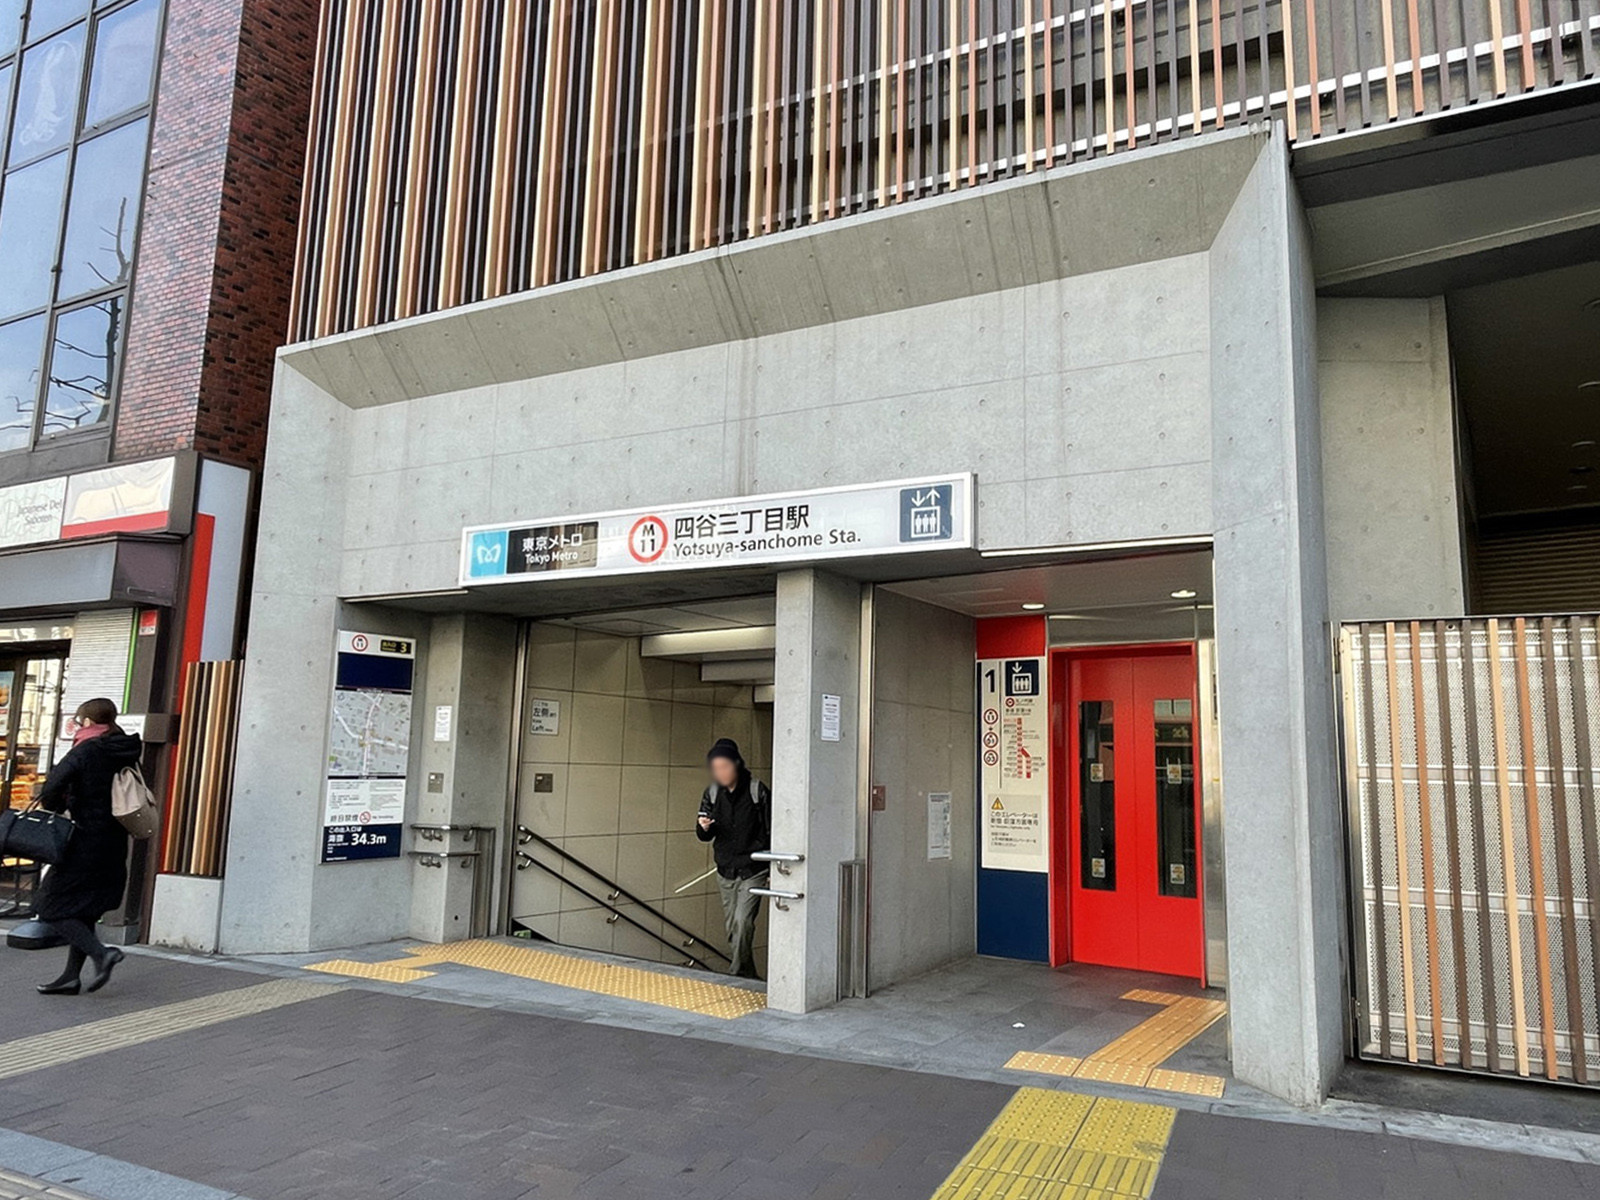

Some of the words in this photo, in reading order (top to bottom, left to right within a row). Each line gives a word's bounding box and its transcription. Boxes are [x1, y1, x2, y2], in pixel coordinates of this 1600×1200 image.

[674, 505, 810, 540] 四谷三丁目駅
[642, 524, 655, 537] M
[522, 533, 583, 552] 東京メトロ
[640, 538, 656, 552] 11
[673, 530, 823, 557] Yotsuya-sanchome
[829, 528, 862, 545] Sta.
[525, 553, 551, 565] Tokyo
[551, 550, 578, 562] Metro
[401, 642, 407, 653] 3
[985, 669, 995, 693] 1
[351, 833, 387, 846] 34.3m
